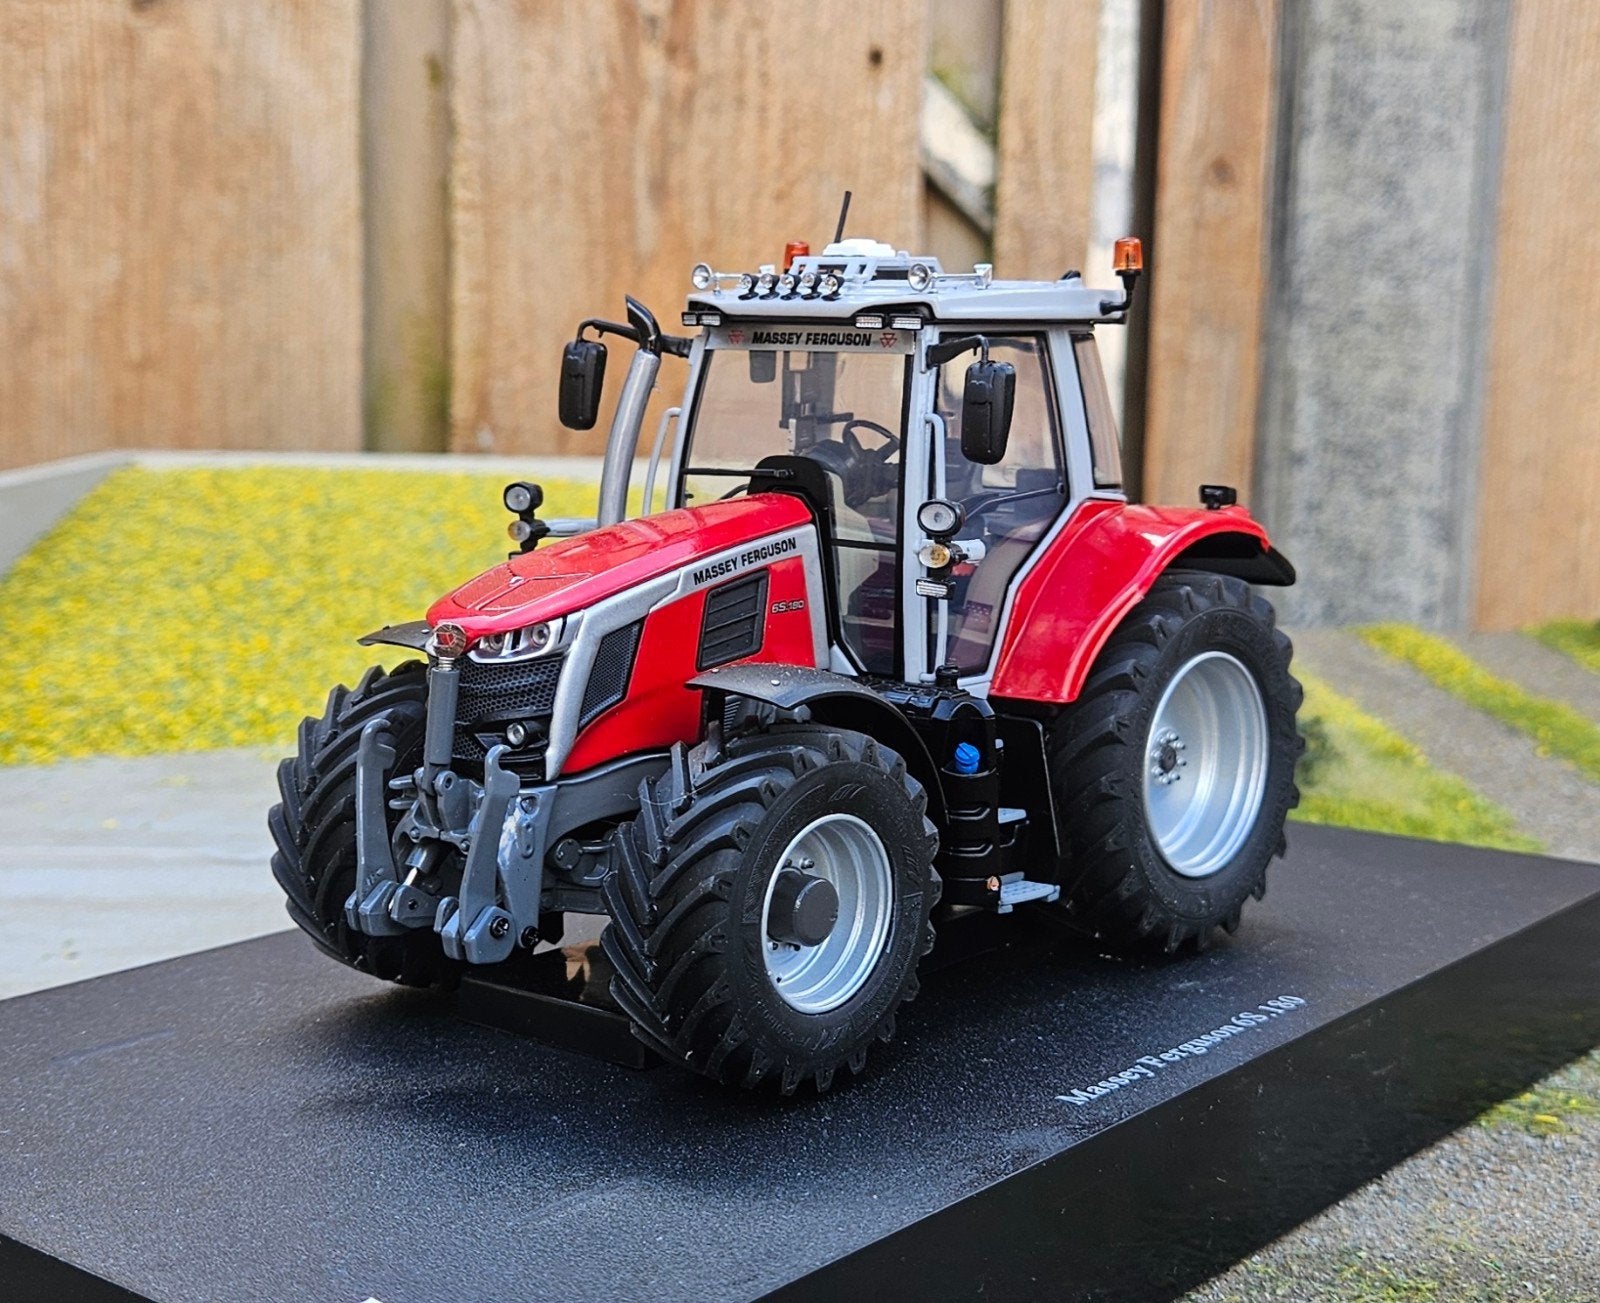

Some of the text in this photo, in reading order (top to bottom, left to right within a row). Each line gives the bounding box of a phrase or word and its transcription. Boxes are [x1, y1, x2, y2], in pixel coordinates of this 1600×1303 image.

[752, 331, 873, 347] MASSEY FERGUSON
[693, 537, 797, 586] MASSEY FERGUSON
[1055, 1063, 1156, 1106] Massey
[1136, 1025, 1245, 1068] Ferguson
